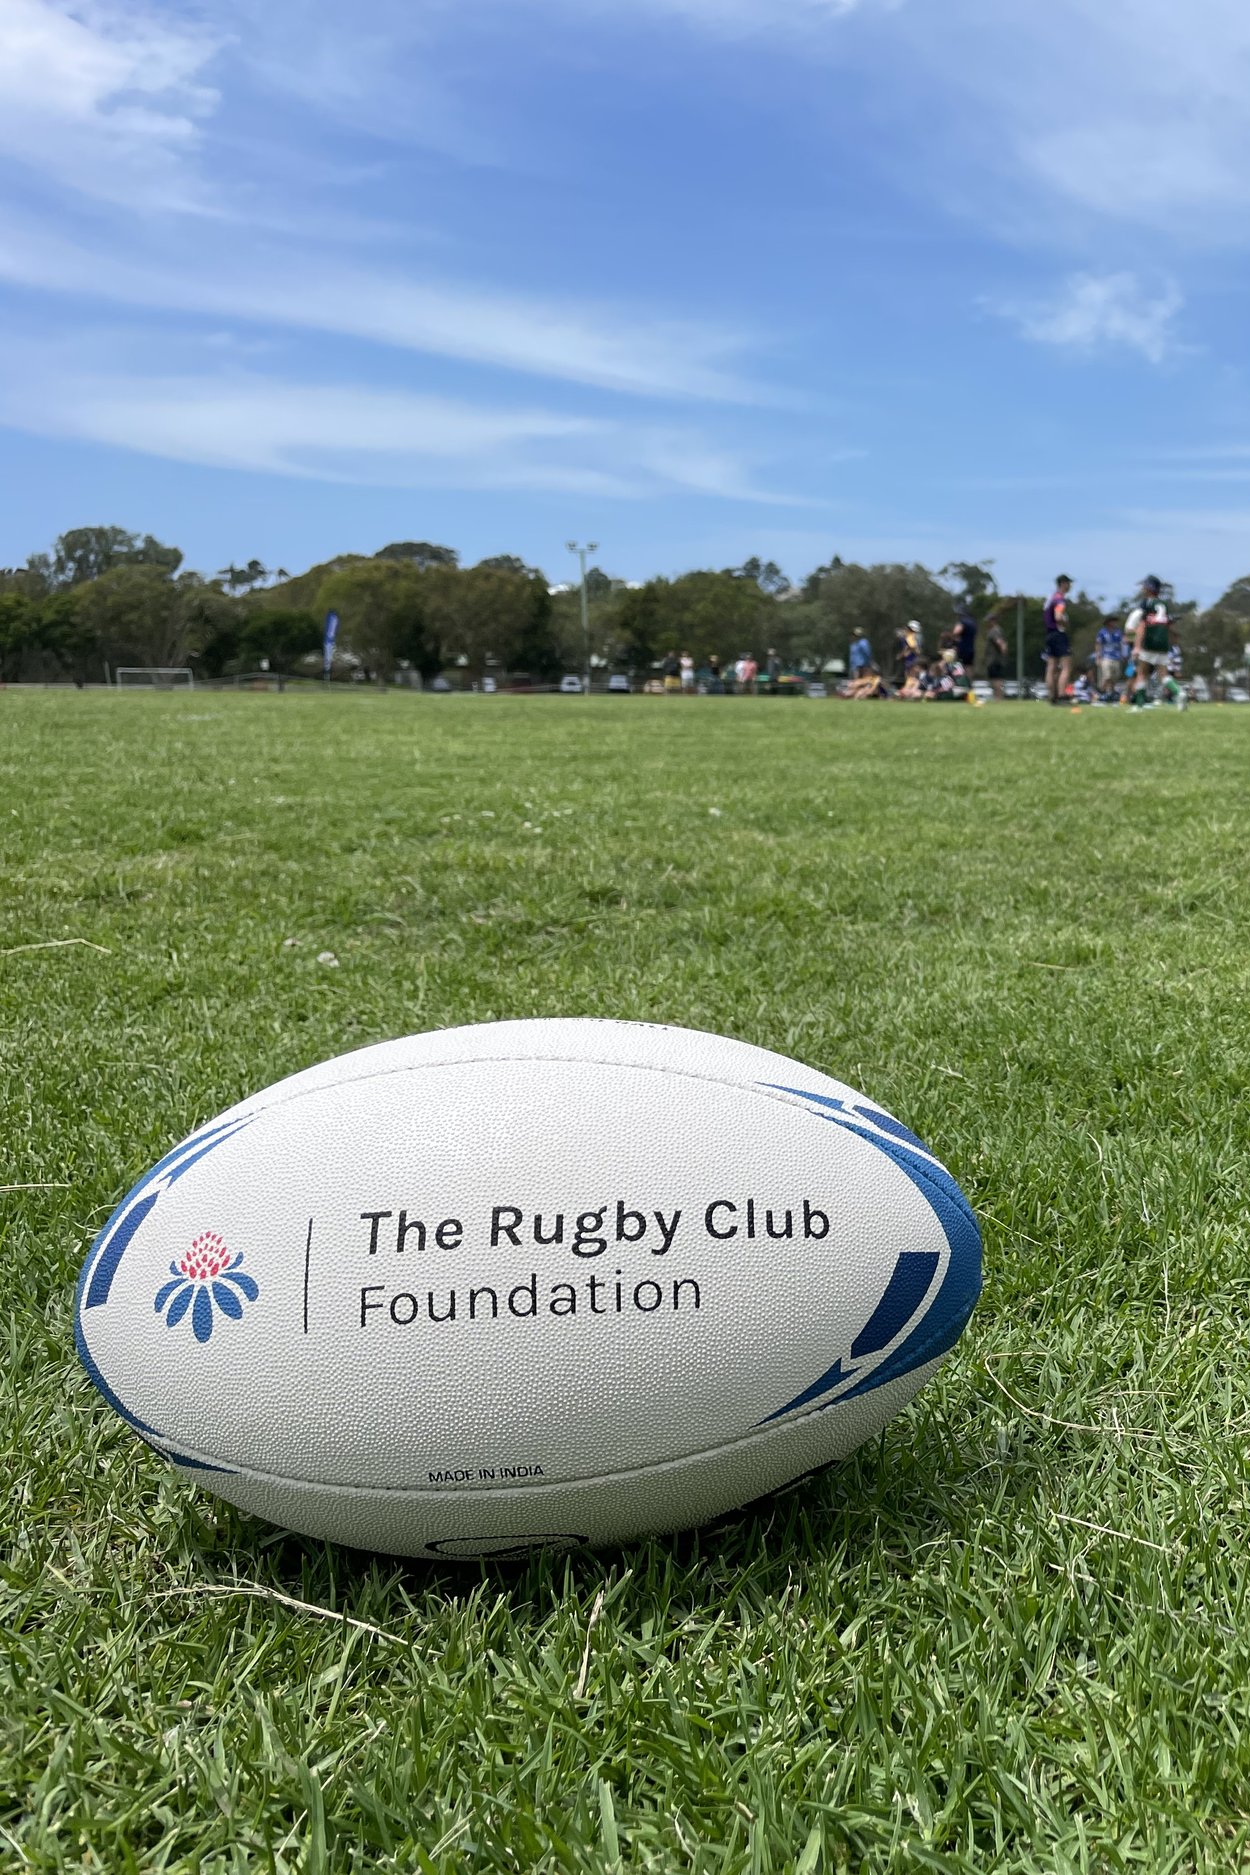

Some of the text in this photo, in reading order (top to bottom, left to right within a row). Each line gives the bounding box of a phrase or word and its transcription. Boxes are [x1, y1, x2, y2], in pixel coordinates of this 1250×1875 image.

[361, 1199, 831, 1258] The Rugby Club
[361, 1269, 701, 1328] Foundation
[428, 1466, 544, 1482] MADE IN INDIA
